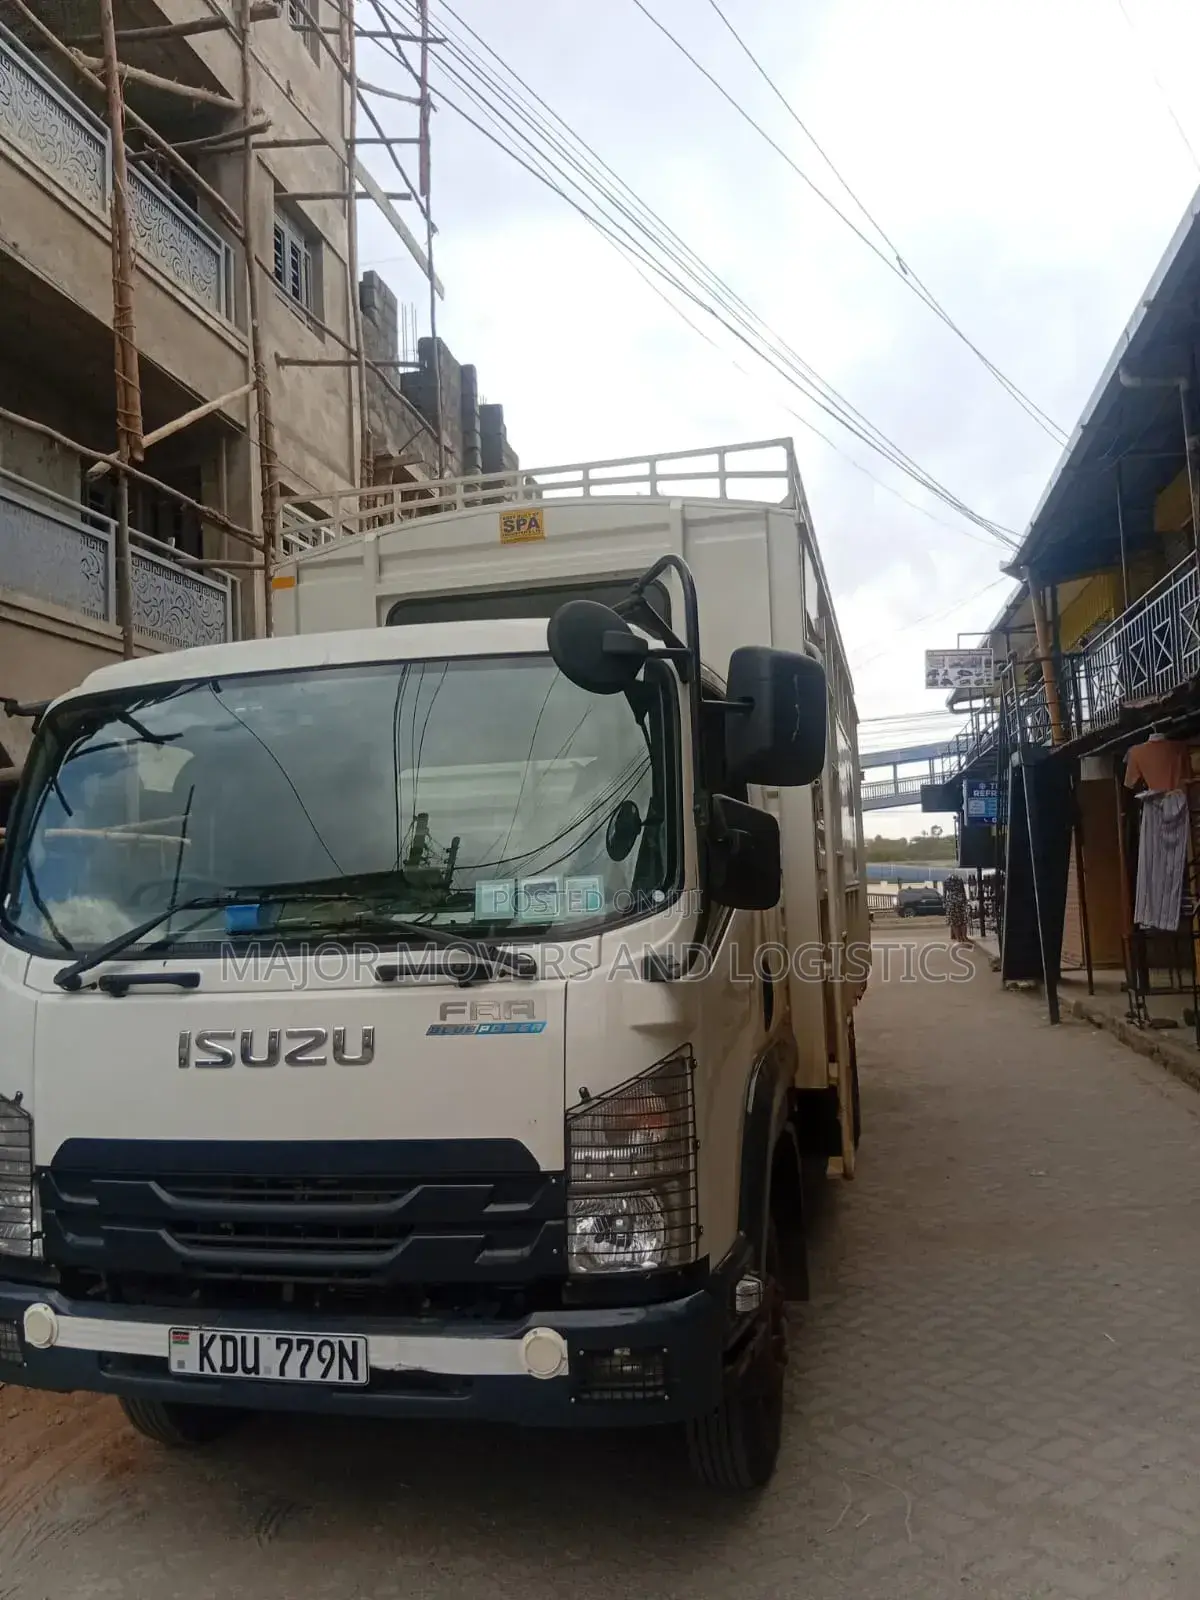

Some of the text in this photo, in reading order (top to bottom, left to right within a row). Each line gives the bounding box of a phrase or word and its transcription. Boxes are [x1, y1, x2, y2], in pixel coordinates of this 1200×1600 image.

[503, 517, 541, 533] SPA
[178, 1026, 376, 1069] ISUZU
[199, 1333, 359, 1381] KDU 779N
